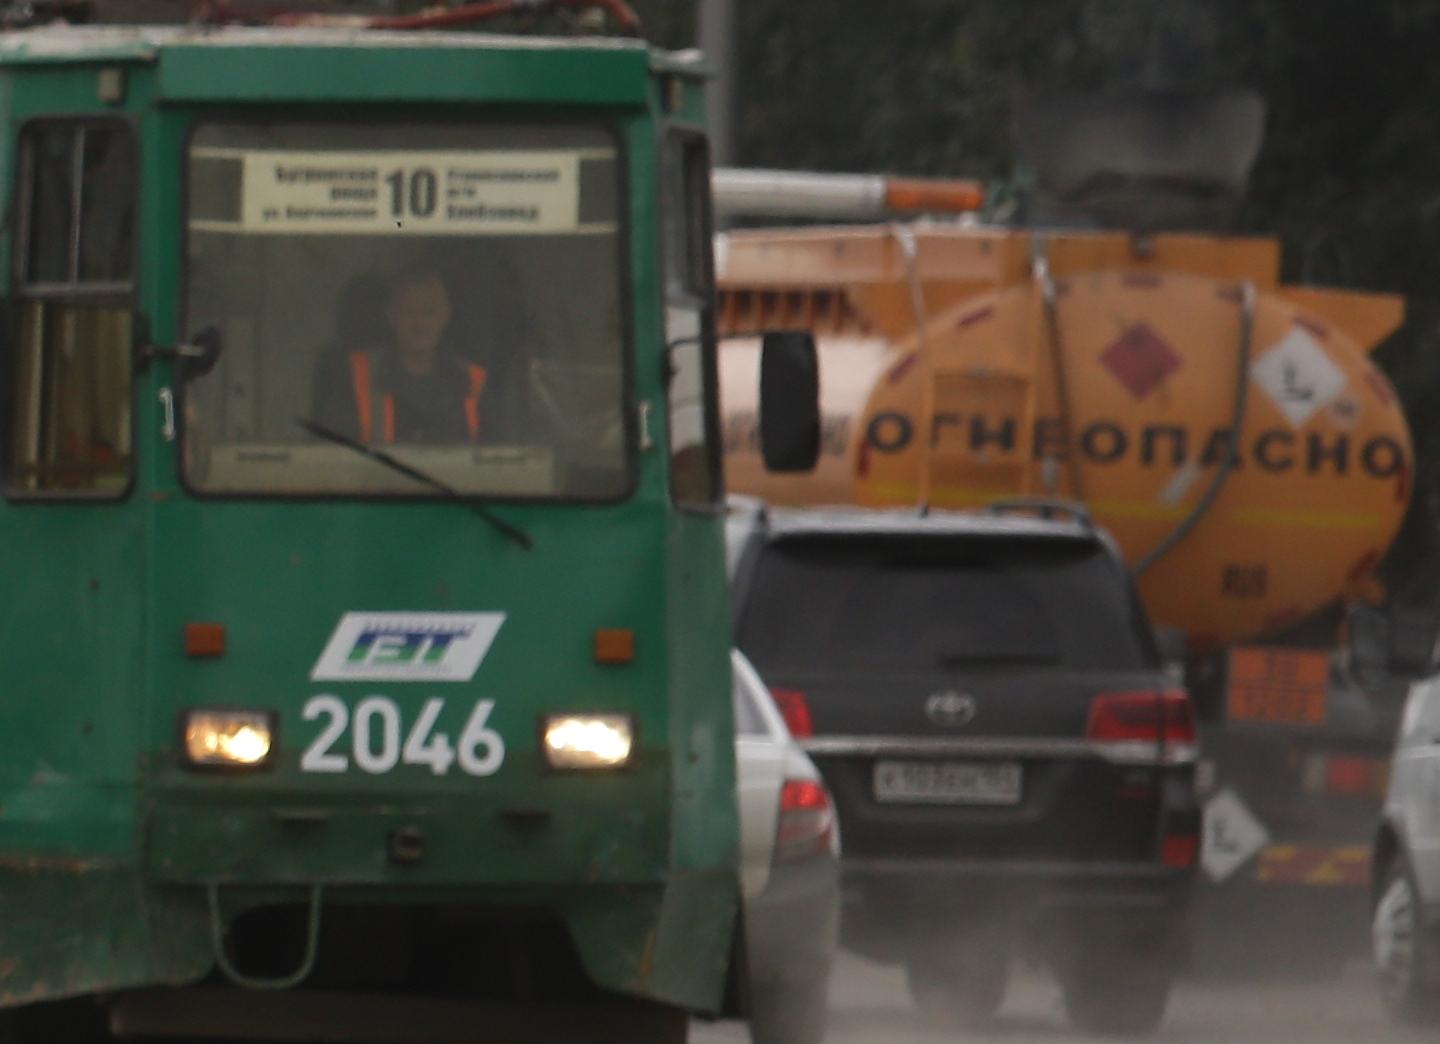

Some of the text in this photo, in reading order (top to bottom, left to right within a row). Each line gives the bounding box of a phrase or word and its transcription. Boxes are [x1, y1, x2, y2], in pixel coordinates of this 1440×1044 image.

[385, 167, 437, 219] 10
[866, 412, 1405, 478] ОГНЕОПАСНО
[299, 694, 506, 777] 2046
